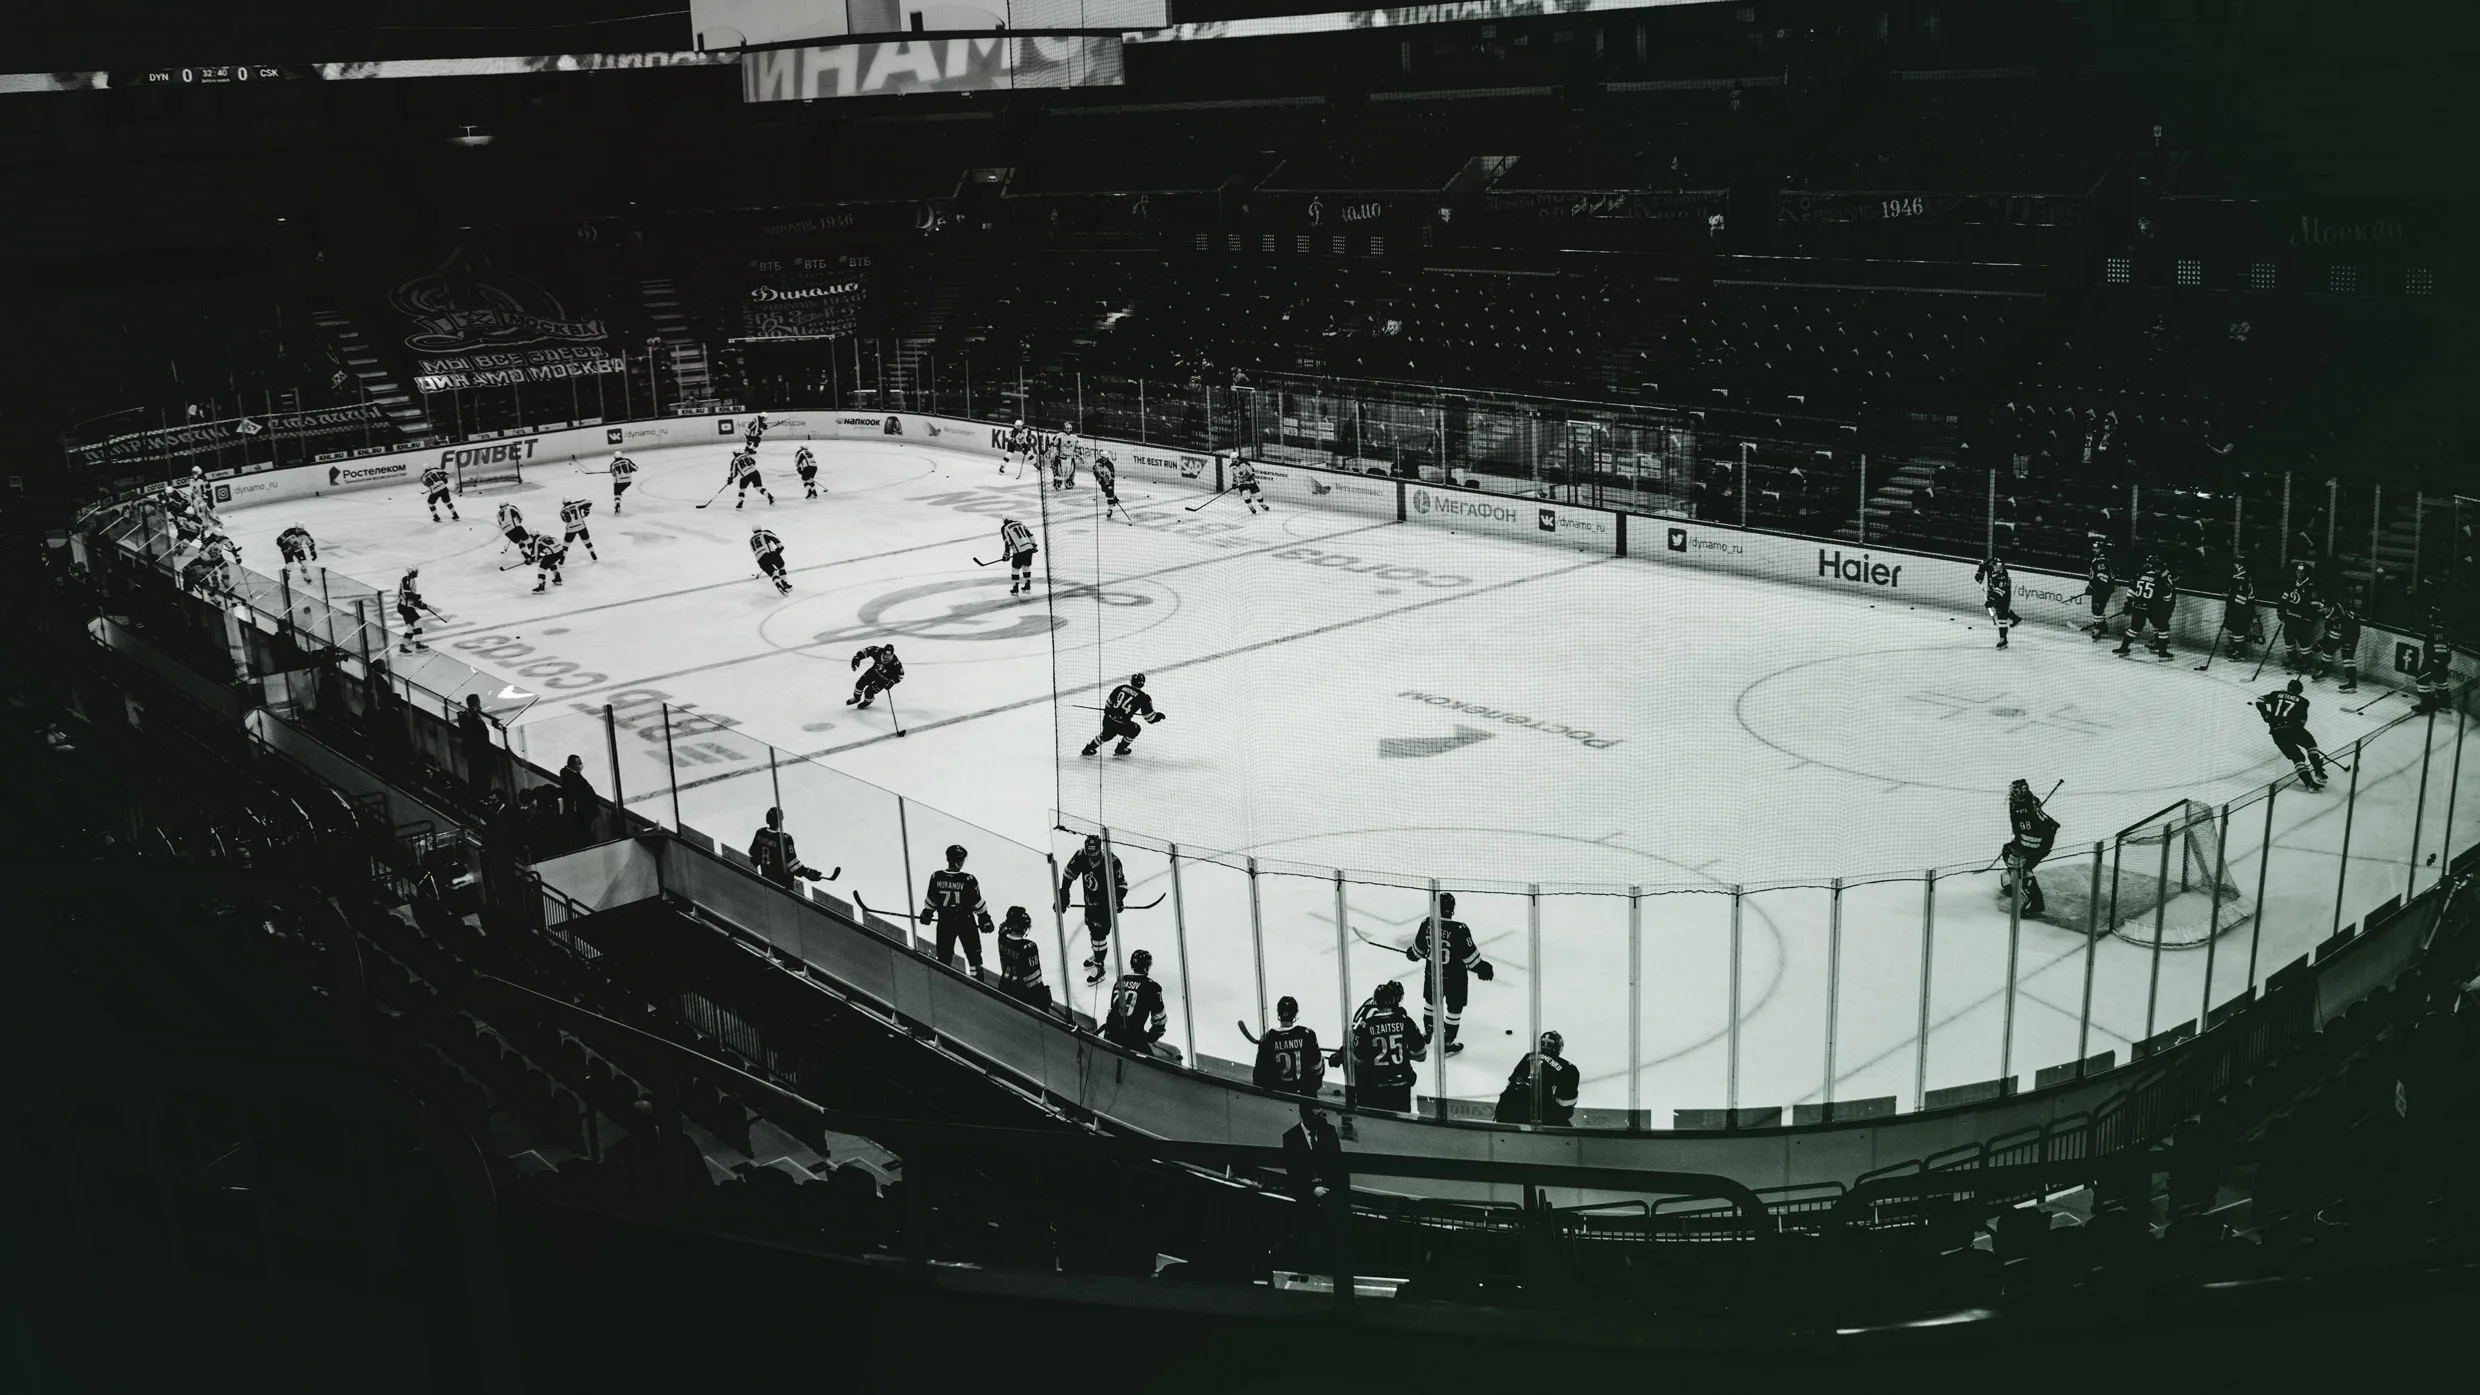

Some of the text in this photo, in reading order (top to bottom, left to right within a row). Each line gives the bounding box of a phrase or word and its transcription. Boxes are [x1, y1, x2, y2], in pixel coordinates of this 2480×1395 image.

[149, 67, 279, 83] DYN 0 32:40 0 CSK
[1881, 197, 1923, 219] 1946
[759, 256, 872, 272] ВТБ ВТБ ВТБ
[751, 281, 860, 303] Динамо
[421, 346, 607, 376] МЫ ВСЕ ЗДЕСЬ
[414, 358, 626, 392] ДИНАМО МОСКВА
[441, 438, 539, 470] FONBET
[1134, 456, 1178, 470] THE BEST RUN
[343, 464, 406, 479] Ростелеком
[1557, 516, 1606, 533] /dynamo_ru
[1688, 537, 1744, 555] /dynamo_ru
[1819, 549, 1902, 588] Haier
[2135, 580, 2155, 599] 55
[1113, 691, 1134, 715] 94
[2274, 698, 2296, 717] 17
[1398, 690, 1627, 750] Ростелеком
[2019, 820, 2032, 831] 98
[937, 880, 964, 890] MURANOV
[938, 890, 961, 907] 71
[1028, 954, 1039, 967] 68
[1274, 1038, 1304, 1051] ALANOV
[1372, 1034, 1404, 1066] 25
[1274, 1050, 1301, 1082] 21
